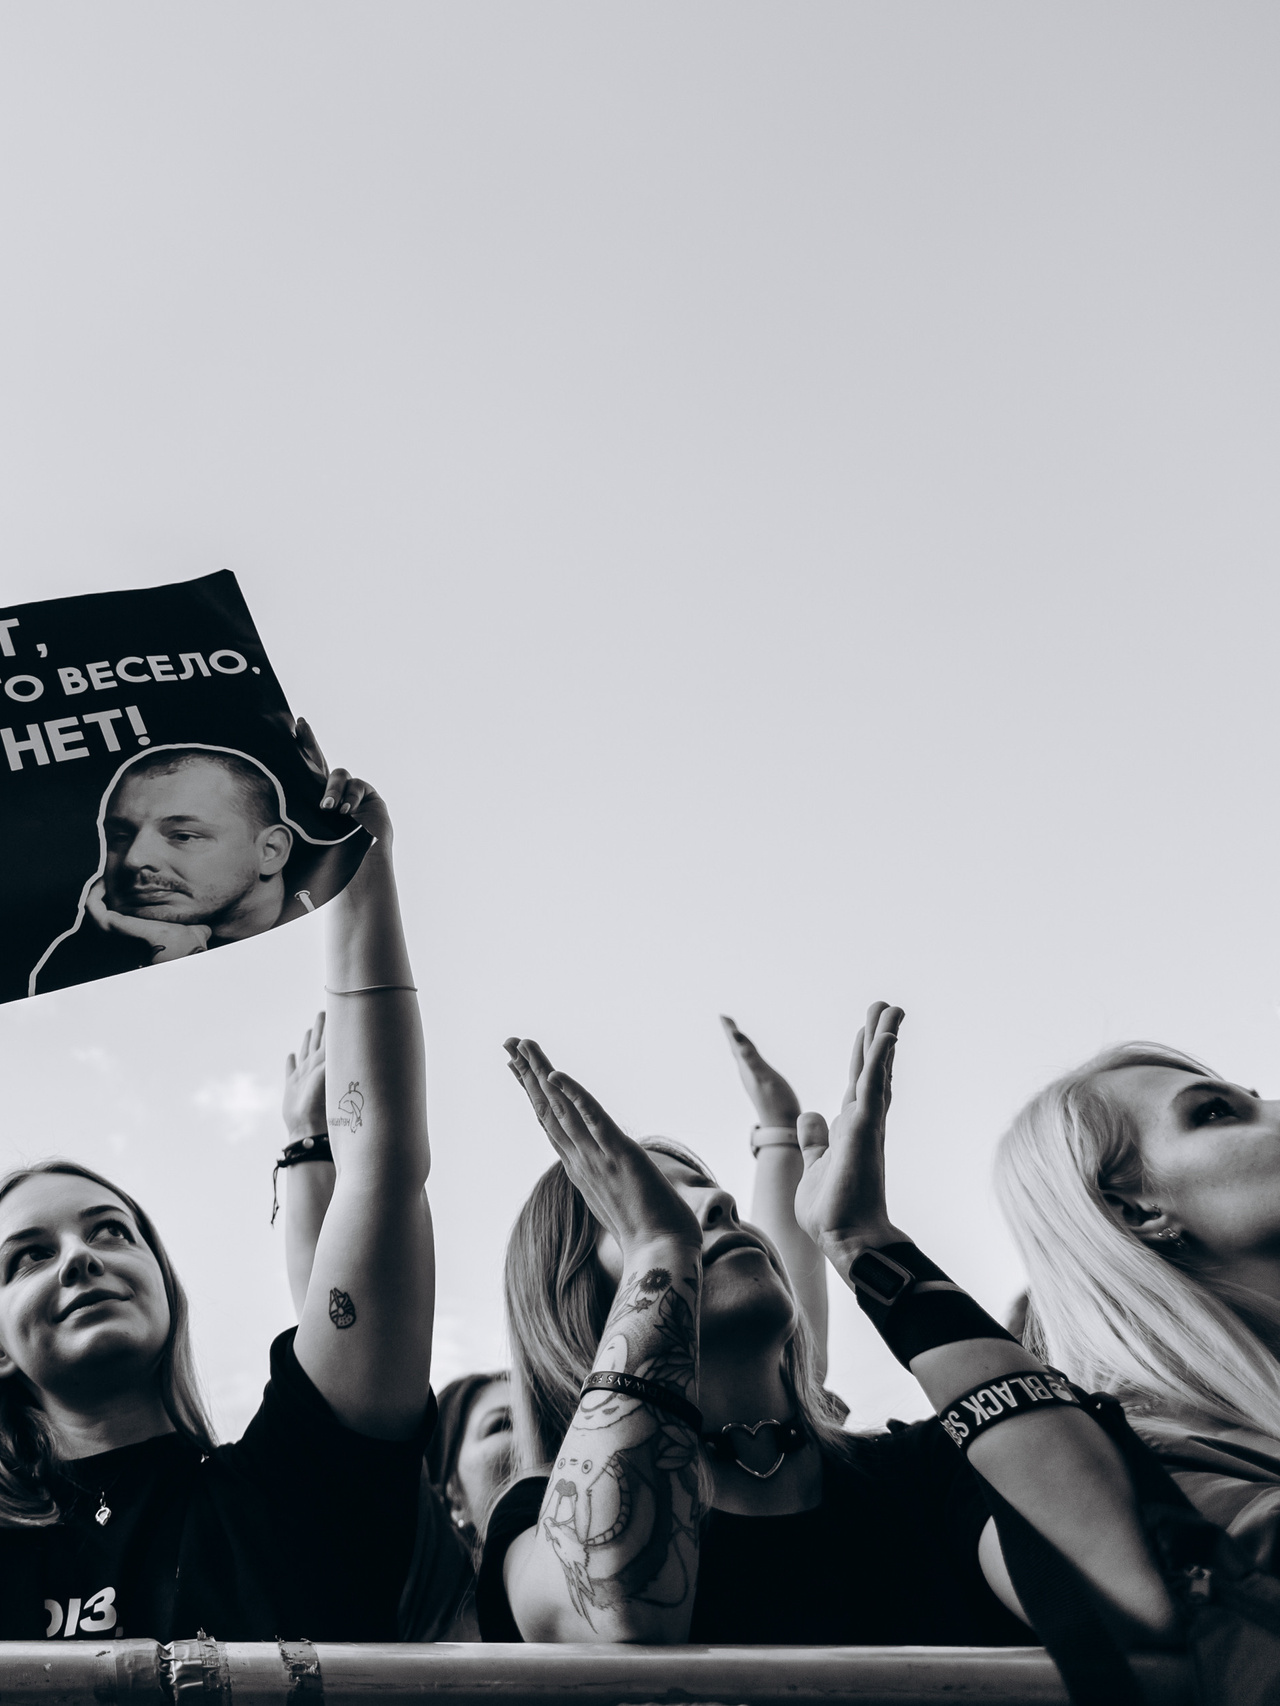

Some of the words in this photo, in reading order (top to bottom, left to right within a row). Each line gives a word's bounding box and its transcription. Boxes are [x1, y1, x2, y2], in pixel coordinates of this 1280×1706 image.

[58, 650, 261, 696] ВЕСЕЛО.
[0, 705, 151, 773] НЕТ!
[960, 1375, 1054, 1426] BLACK
